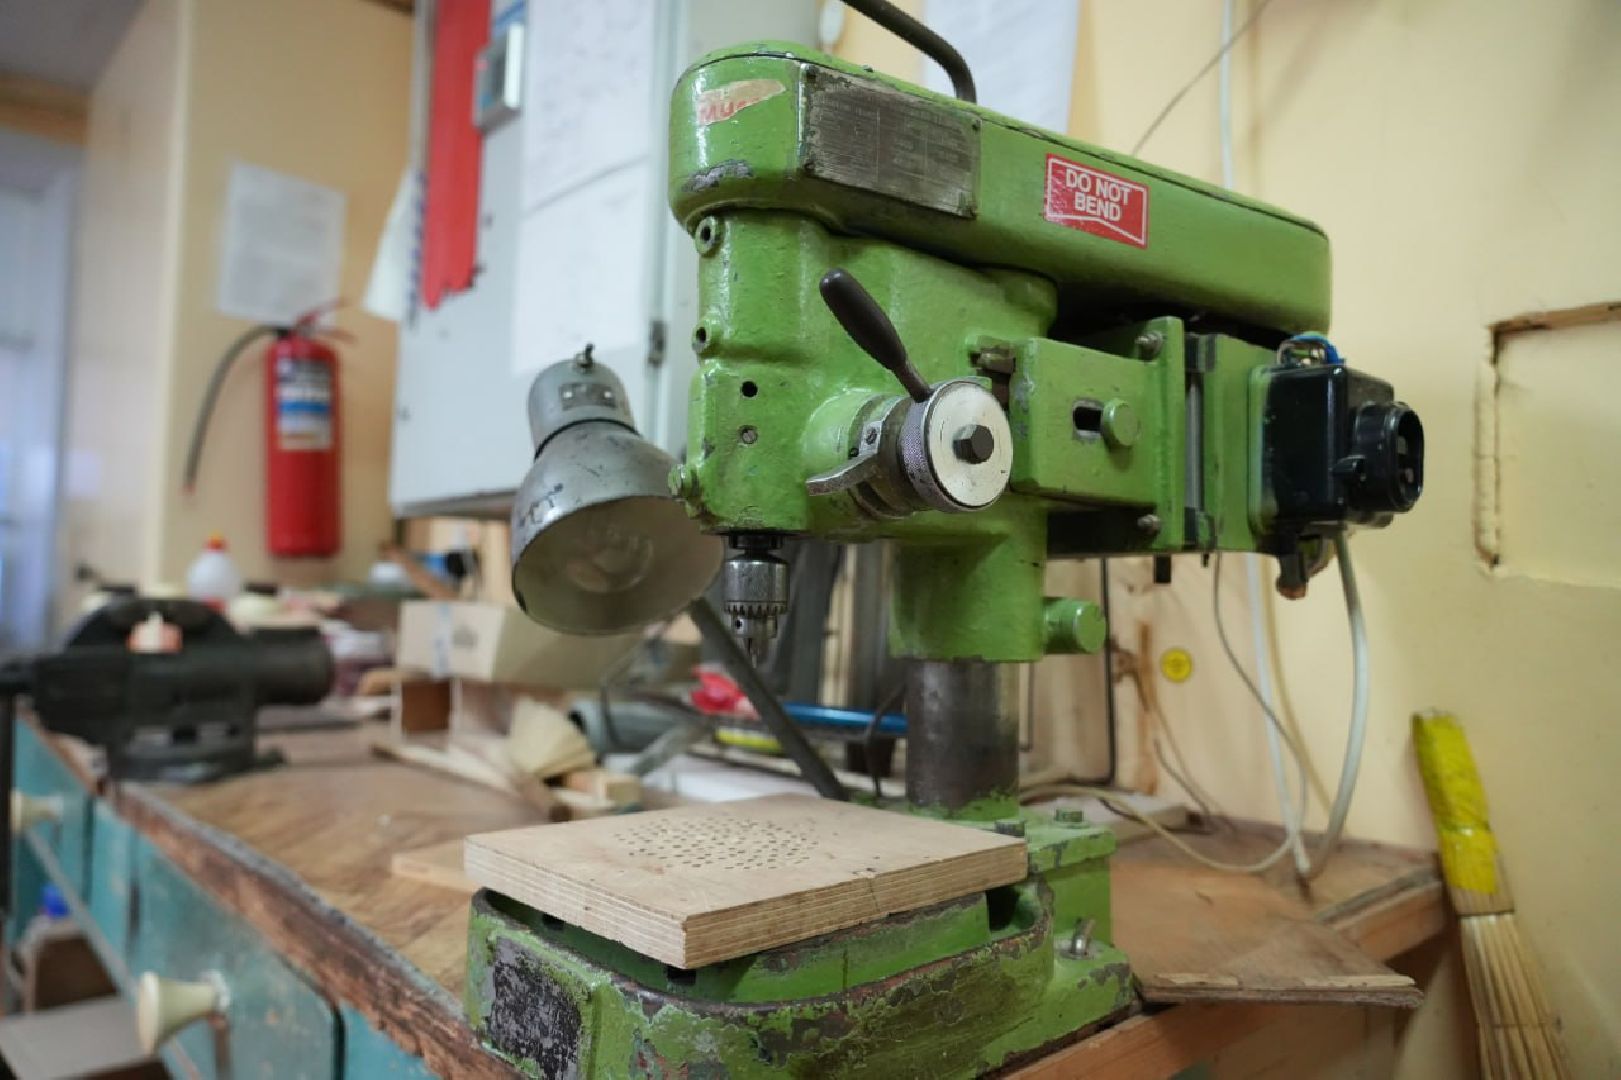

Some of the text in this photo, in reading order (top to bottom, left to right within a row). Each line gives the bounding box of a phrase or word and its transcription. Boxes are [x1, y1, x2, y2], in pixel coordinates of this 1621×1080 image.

[1065, 168, 1131, 205] DO NOT
[1074, 191, 1122, 221] BEND
